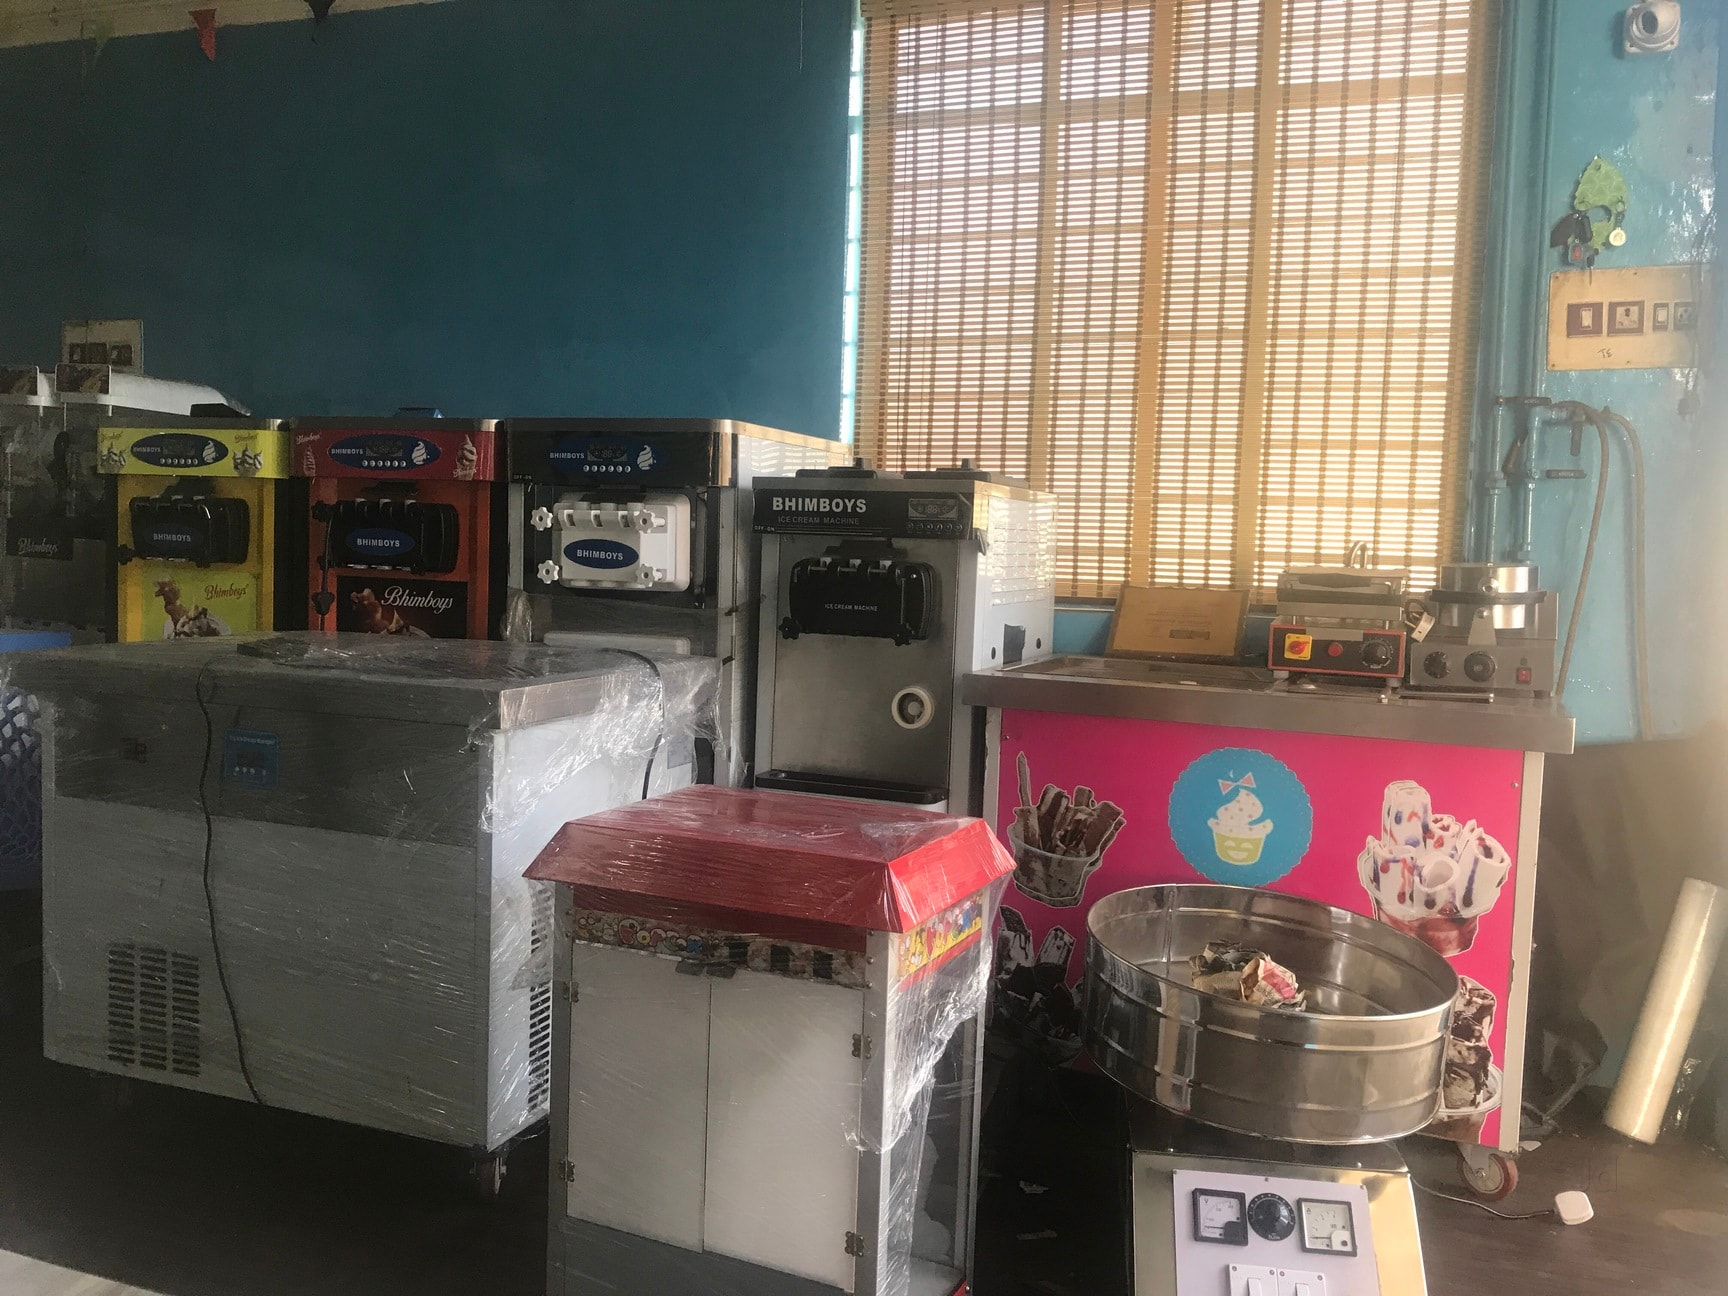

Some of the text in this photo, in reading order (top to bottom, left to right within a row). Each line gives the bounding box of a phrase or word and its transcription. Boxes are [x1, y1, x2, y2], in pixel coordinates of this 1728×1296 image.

[772, 496, 867, 513] BHIMBOYS
[778, 515, 860, 525] ICE CREAM MACHINE
[153, 533, 191, 542] BHIMBOYS
[357, 538, 400, 547] BHIMBOYS
[576, 549, 624, 560] BHIMBOYS
[381, 585, 453, 614] Bhimboys
[854, 604, 878, 612] MACHINE
